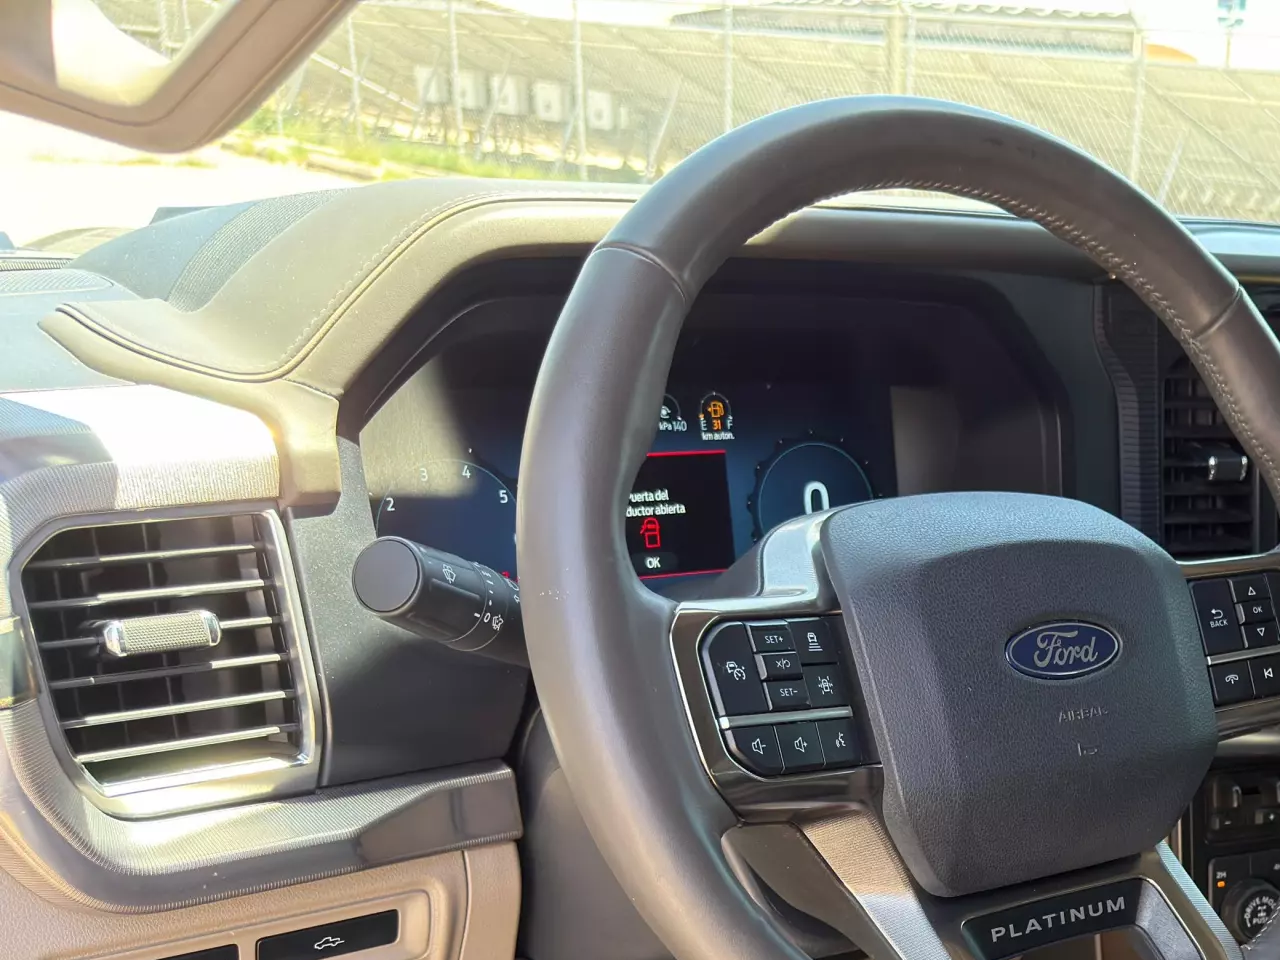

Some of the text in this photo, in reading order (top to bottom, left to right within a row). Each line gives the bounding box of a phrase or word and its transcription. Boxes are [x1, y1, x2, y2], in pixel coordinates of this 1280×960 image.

[673, 420, 688, 432] 140
[701, 419, 734, 431] E 31 F
[419, 467, 429, 482] 3
[461, 465, 471, 479] 4
[499, 489, 509, 504] 5
[629, 488, 670, 503] uerta del
[386, 497, 396, 512] 2
[655, 503, 687, 515] abierta
[646, 556, 661, 569] OK
[1252, 605, 1263, 615] OK
[1209, 618, 1229, 629] BACK
[1033, 630, 1099, 668] Ford
[990, 896, 1126, 943] PLATINUM
